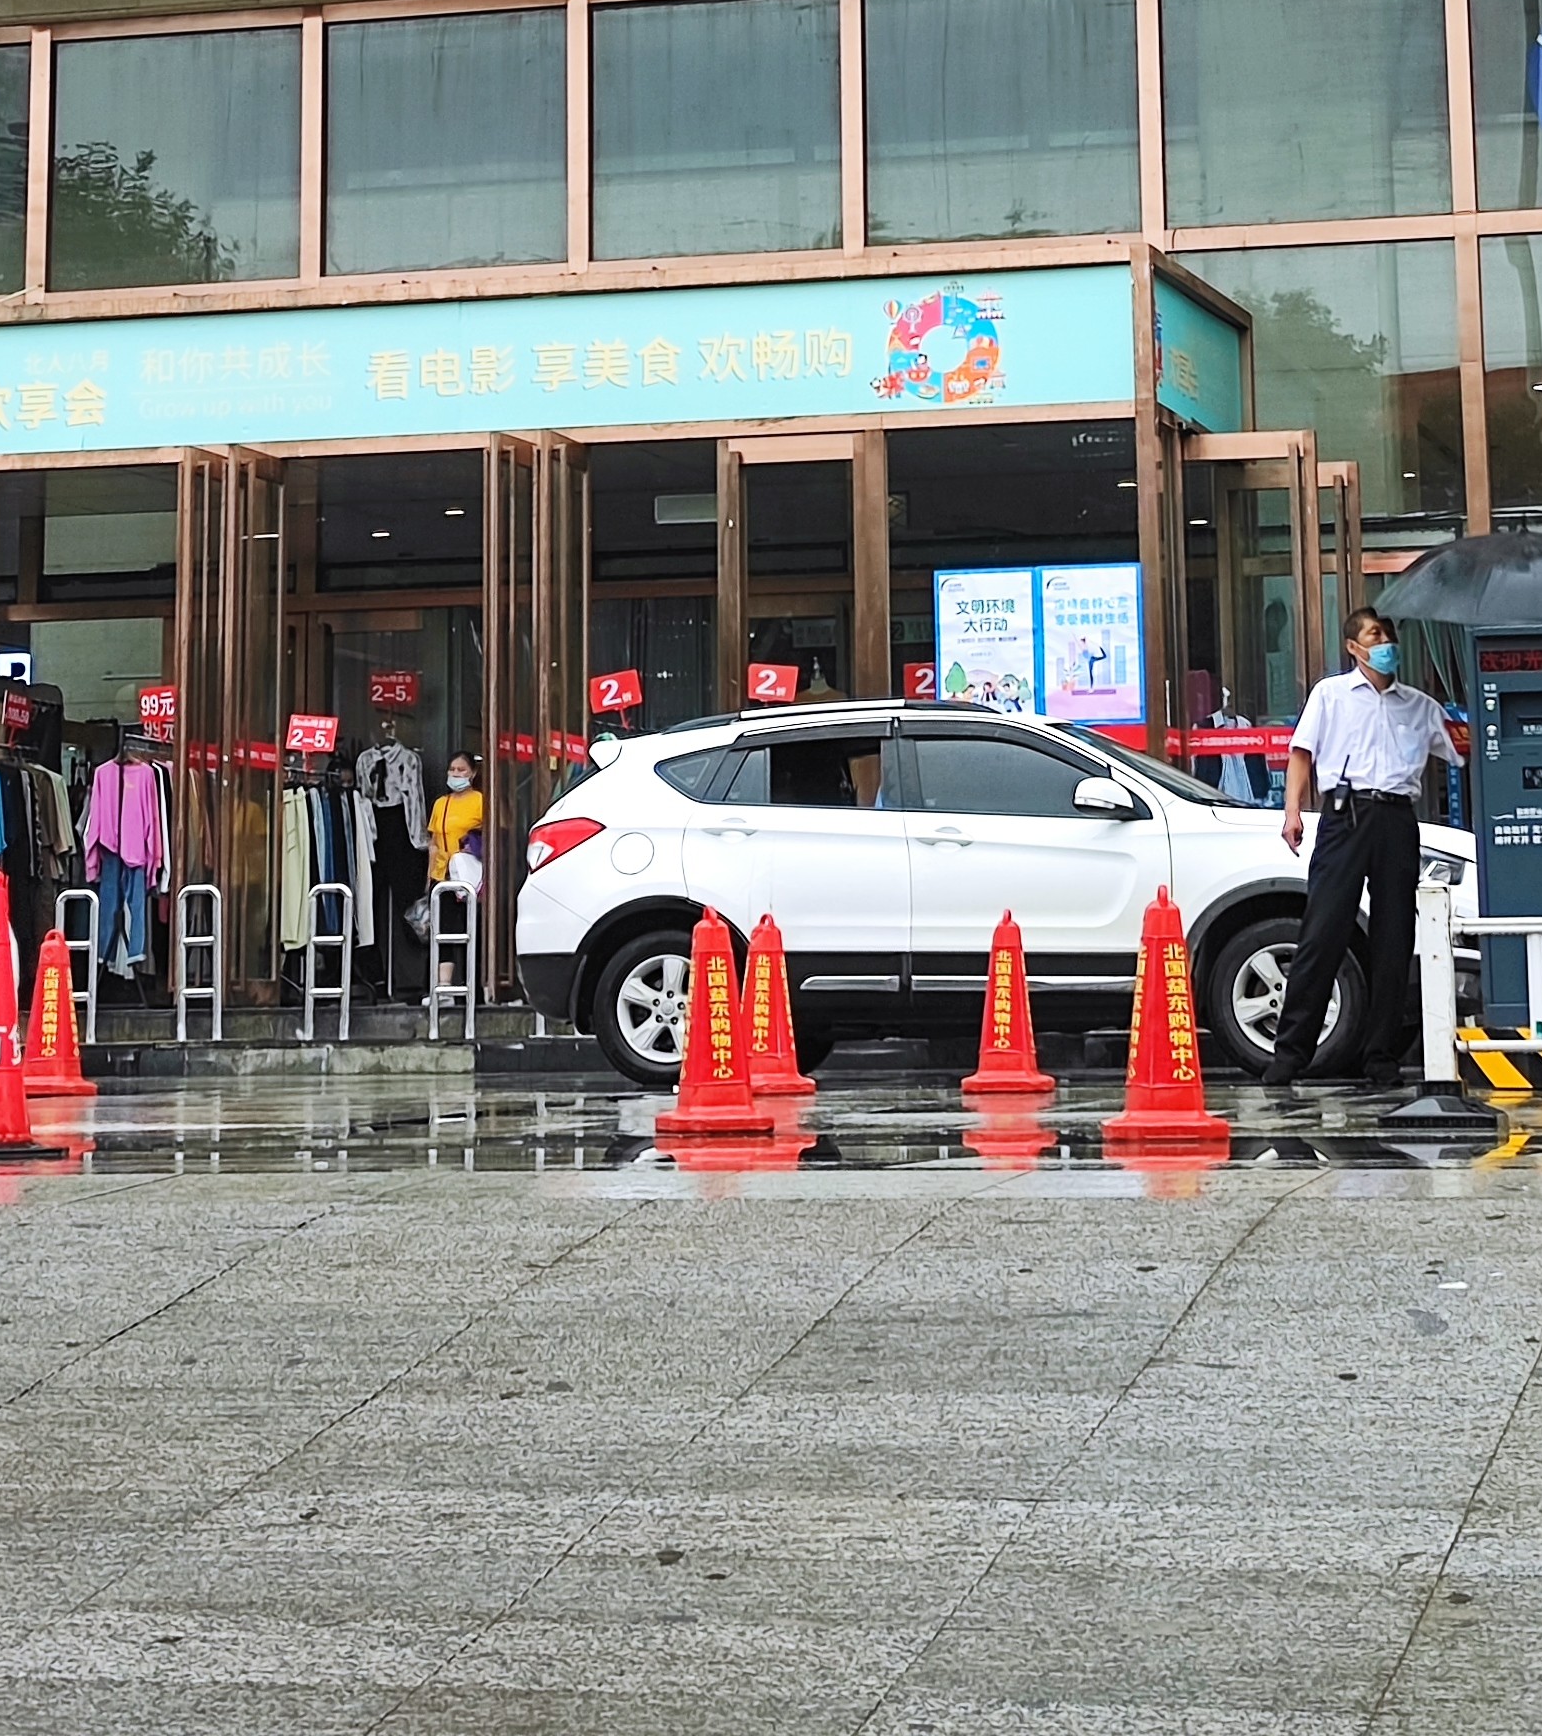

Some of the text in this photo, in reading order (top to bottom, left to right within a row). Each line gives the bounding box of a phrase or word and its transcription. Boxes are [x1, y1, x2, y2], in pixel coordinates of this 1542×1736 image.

[139, 339, 333, 385] 和你共成长
[365, 343, 515, 400] 看电影
[531, 337, 682, 392] 享美食
[698, 327, 854, 384] 欢畅购
[956, 598, 1015, 616] 文明环境
[963, 617, 1008, 634] 大行动
[139, 690, 175, 717] 99元
[706, 955, 735, 1079] 北国益东购物中心
[751, 954, 772, 1053] 北国益东购物中心
[992, 948, 1013, 1051] 北国益东购物中心
[1162, 943, 1196, 1081] 北国益东购物中心
